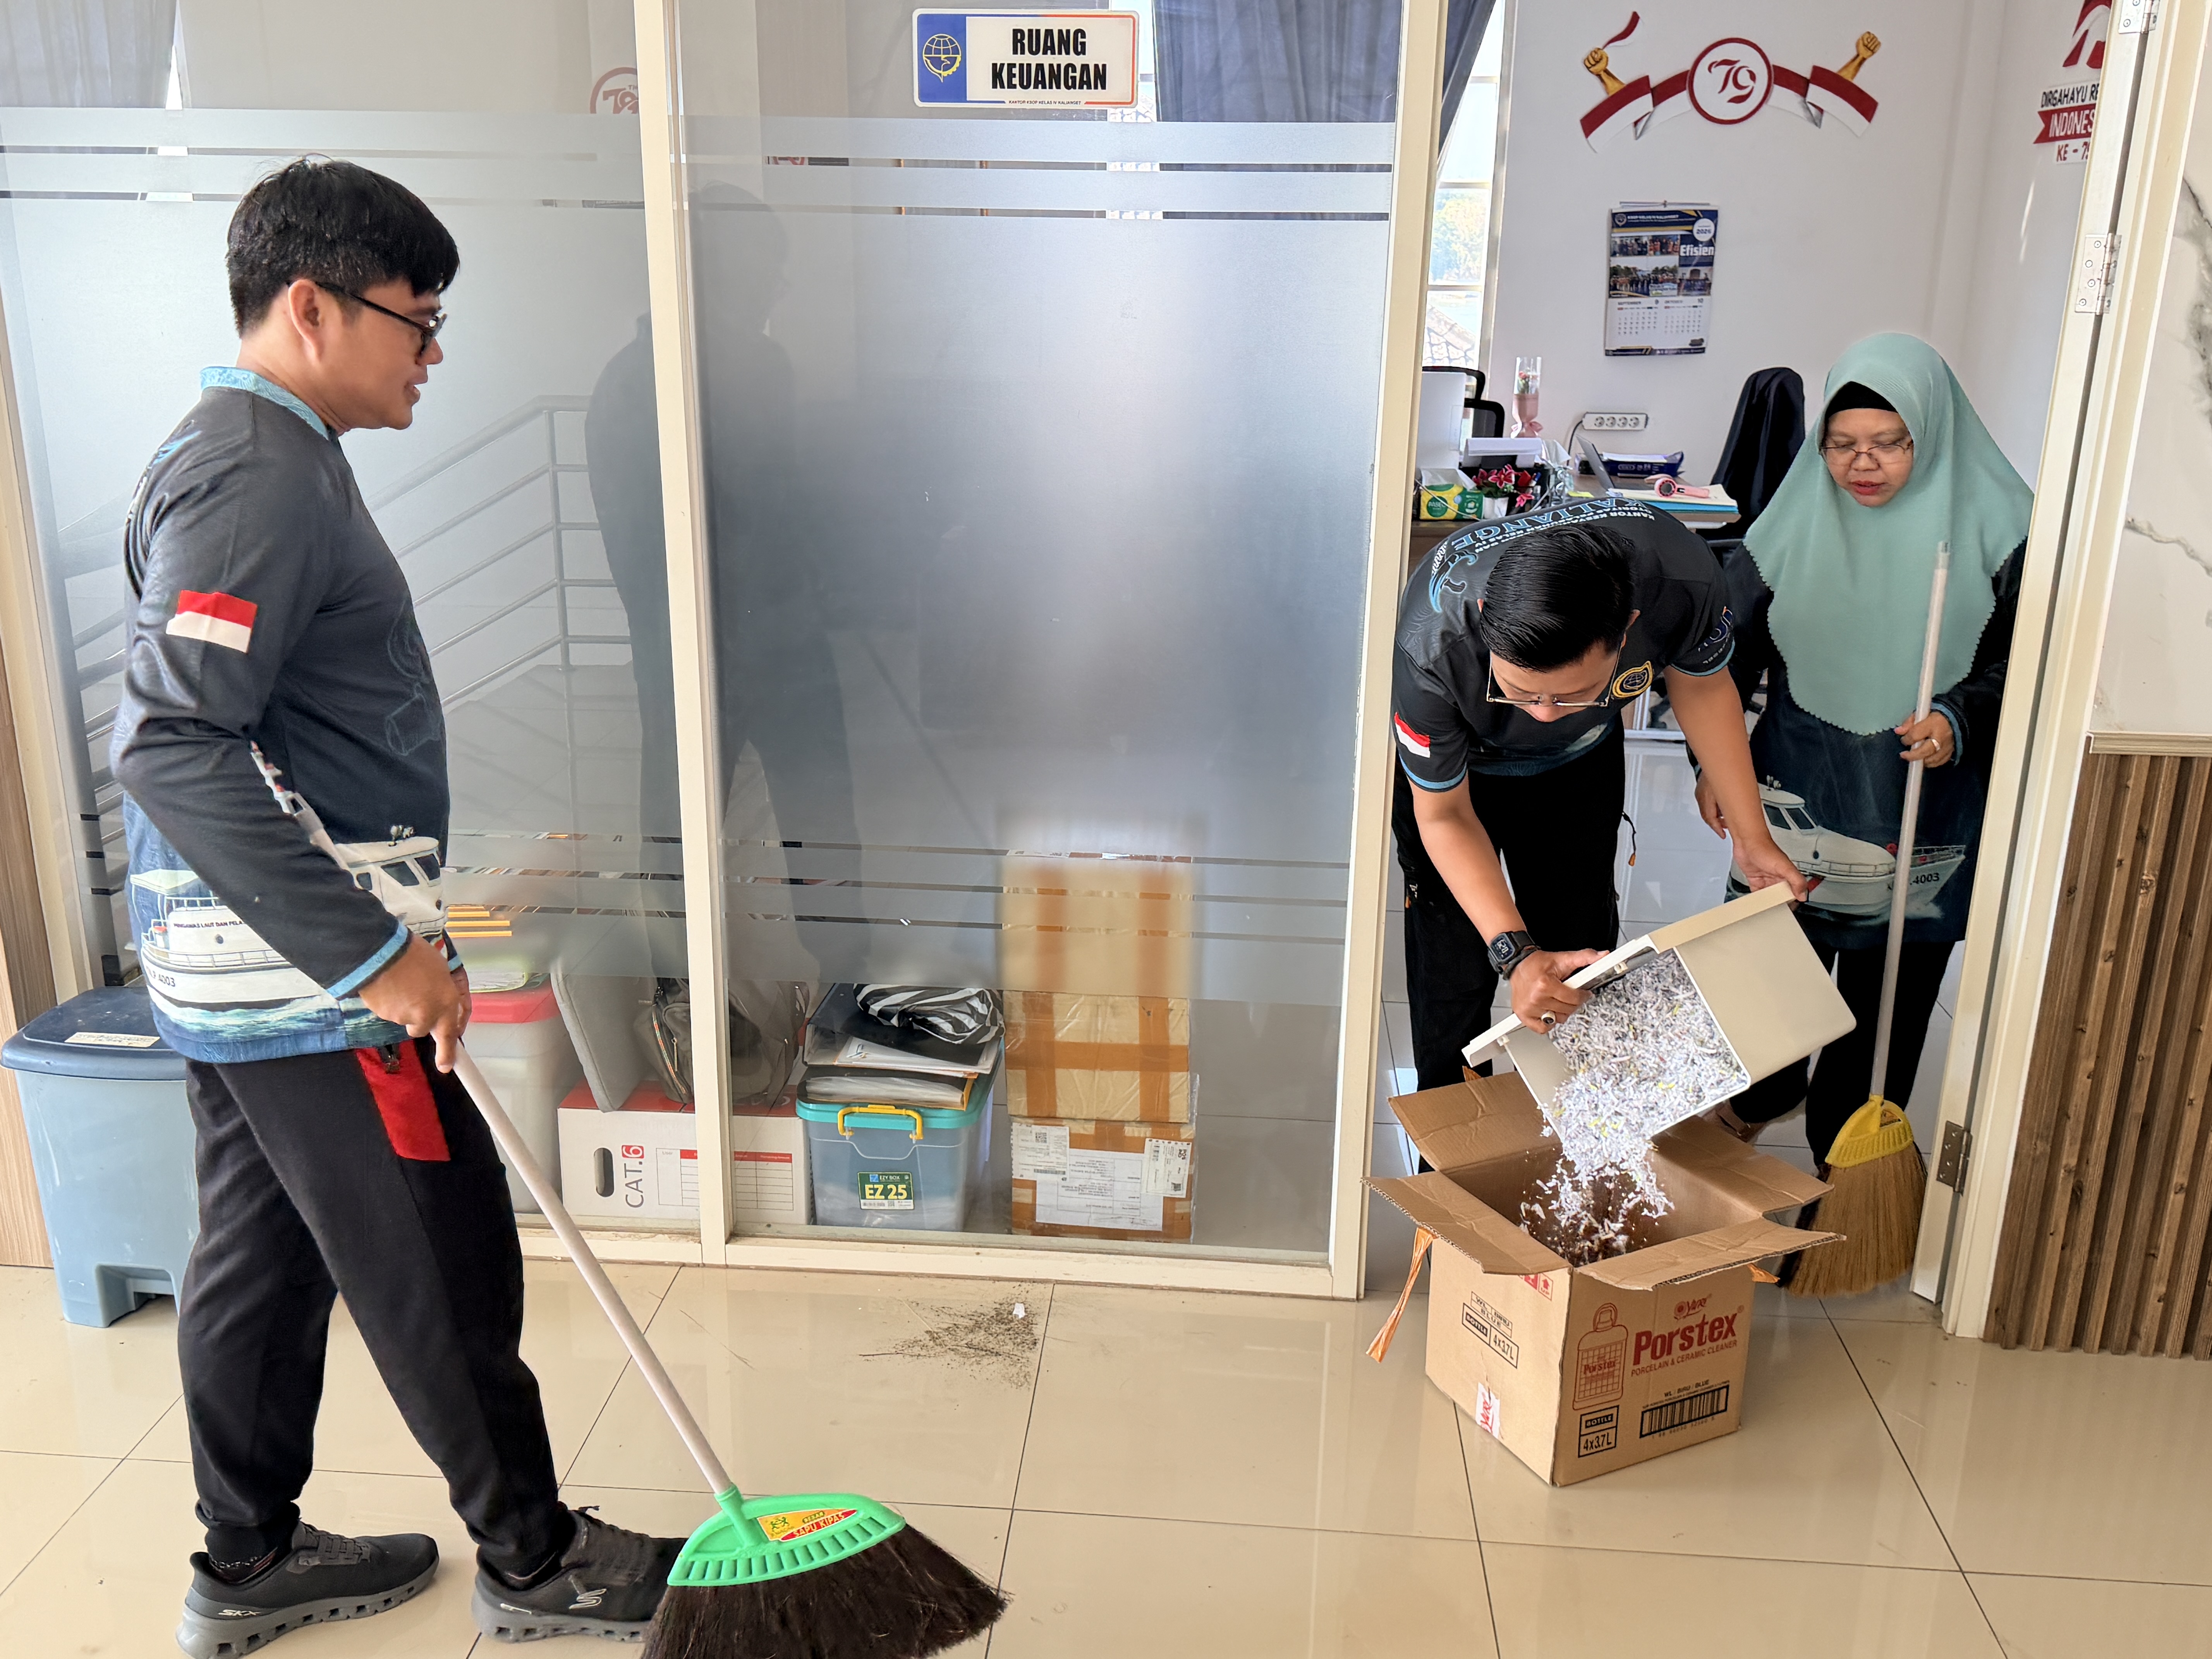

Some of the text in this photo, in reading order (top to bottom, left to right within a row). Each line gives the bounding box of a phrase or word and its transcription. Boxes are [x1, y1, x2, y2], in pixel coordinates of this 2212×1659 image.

[1012, 28, 1086, 55] RUANG
[991, 63, 1107, 90] KEUANGAN
[1708, 58, 1757, 104] 79
[2056, 144, 2069, 162] KE
[1680, 245, 1714, 256] Efisien
[1610, 511, 1655, 520] KANTOR
[1490, 530, 1524, 541] KELAS
[865, 1184, 907, 1199] EZ 25
[1476, 1297, 1487, 1309] WL
[1466, 1313, 1488, 1336] BOTTLE
[1481, 1308, 1501, 1328] BLUE
[1633, 1313, 1737, 1366] Porstex
[1631, 1359, 1669, 1377] PORCELAIN
[1676, 1349, 1706, 1364] CERAMIC
[1707, 1340, 1737, 1354] CLEANER
[1695, 1379, 1709, 1388] BLUE
[1586, 1415, 1612, 1427] BOTTLE
[793, 1524, 817, 1537] SAPU
[819, 1513, 845, 1528] KIPAS
[804, 1511, 824, 1523] BESAR
